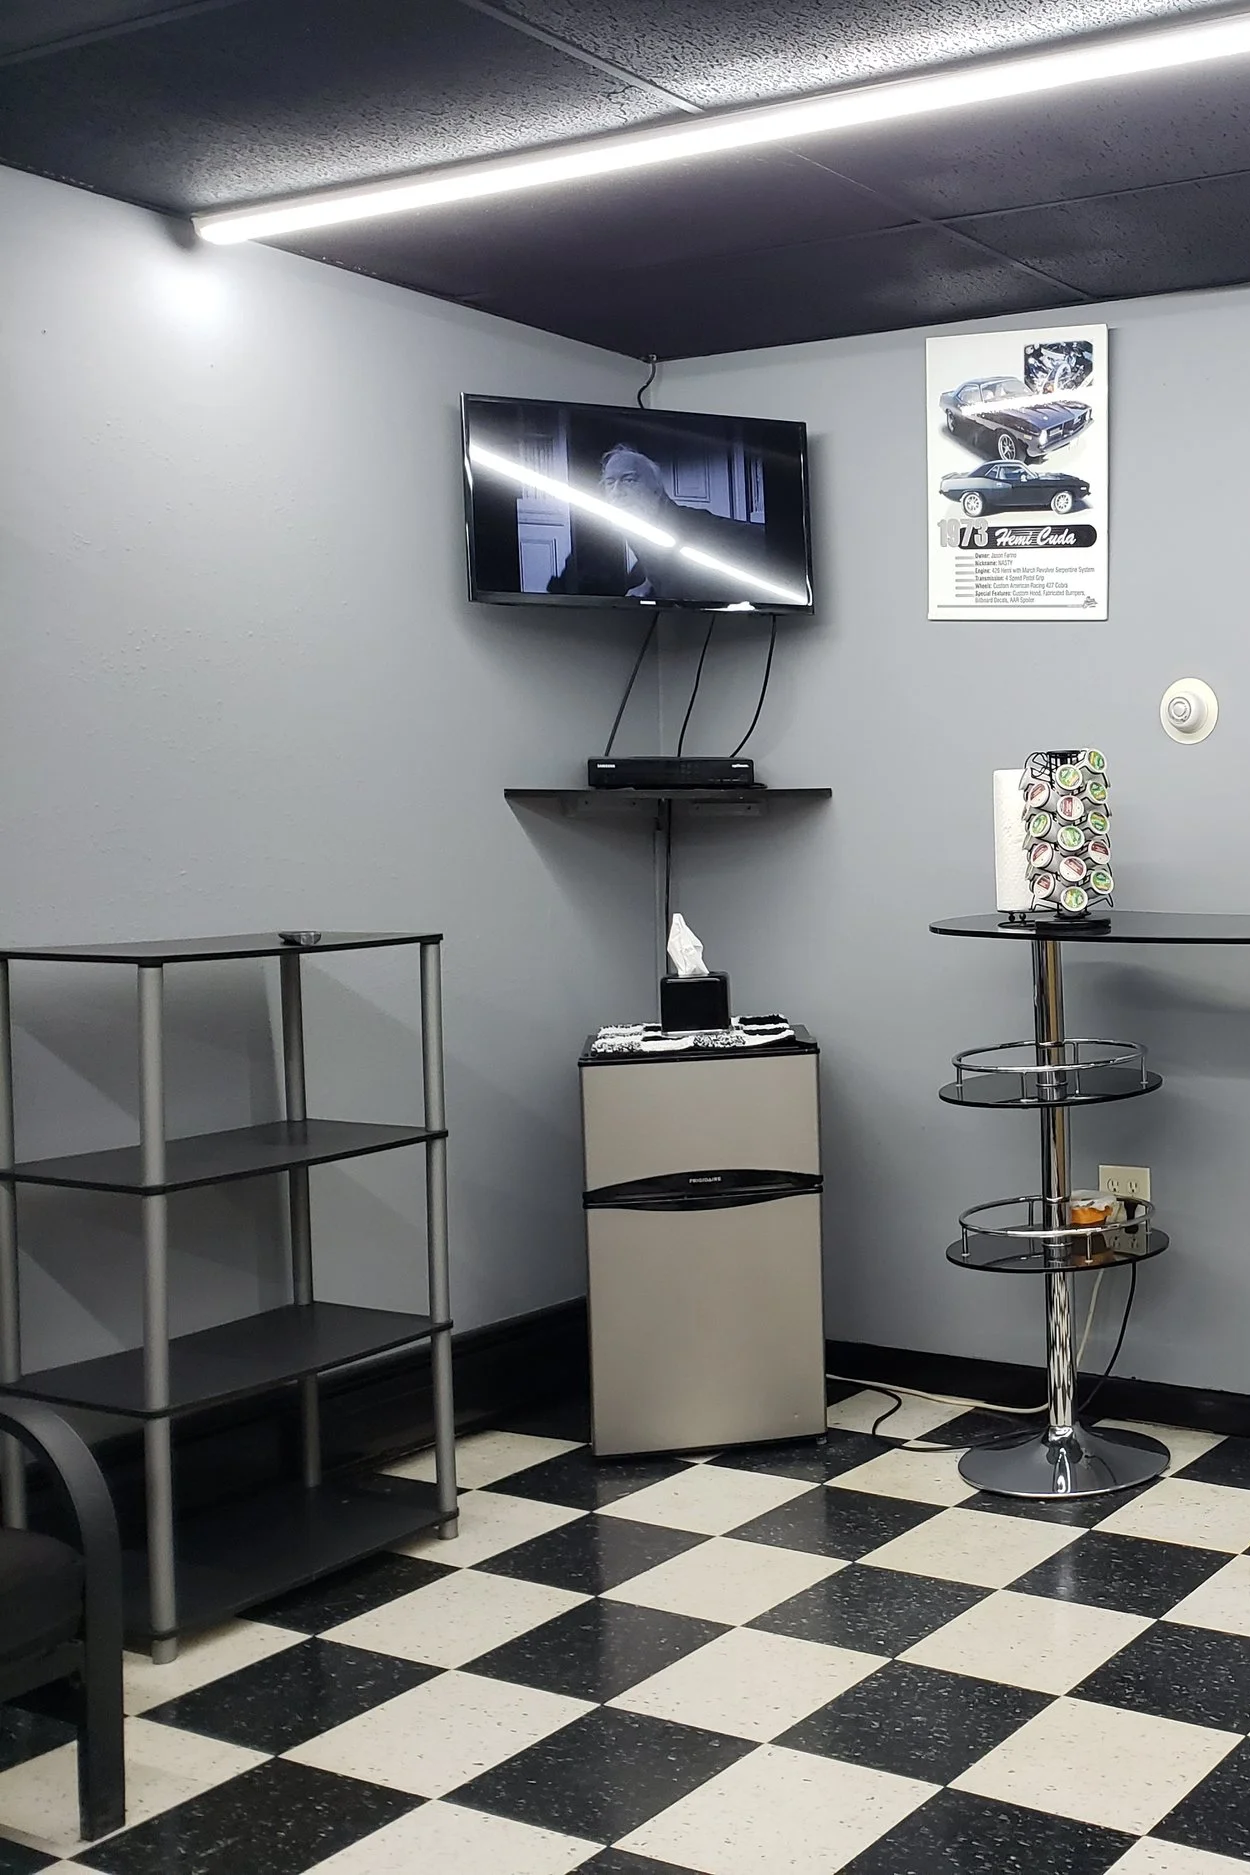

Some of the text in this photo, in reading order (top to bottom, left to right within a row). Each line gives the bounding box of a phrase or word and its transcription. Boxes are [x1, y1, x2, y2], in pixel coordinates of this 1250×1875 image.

[937, 518, 989, 548] 1973
[995, 526, 1077, 547] Hemi Cuda
[1078, 566, 1095, 574] System
[1009, 574, 1023, 582] Speed
[1030, 582, 1046, 590] Racing
[1055, 581, 1069, 589] Cobra
[1012, 589, 1029, 597] Custom
[689, 1176, 722, 1184] FRIGIDAIRE
